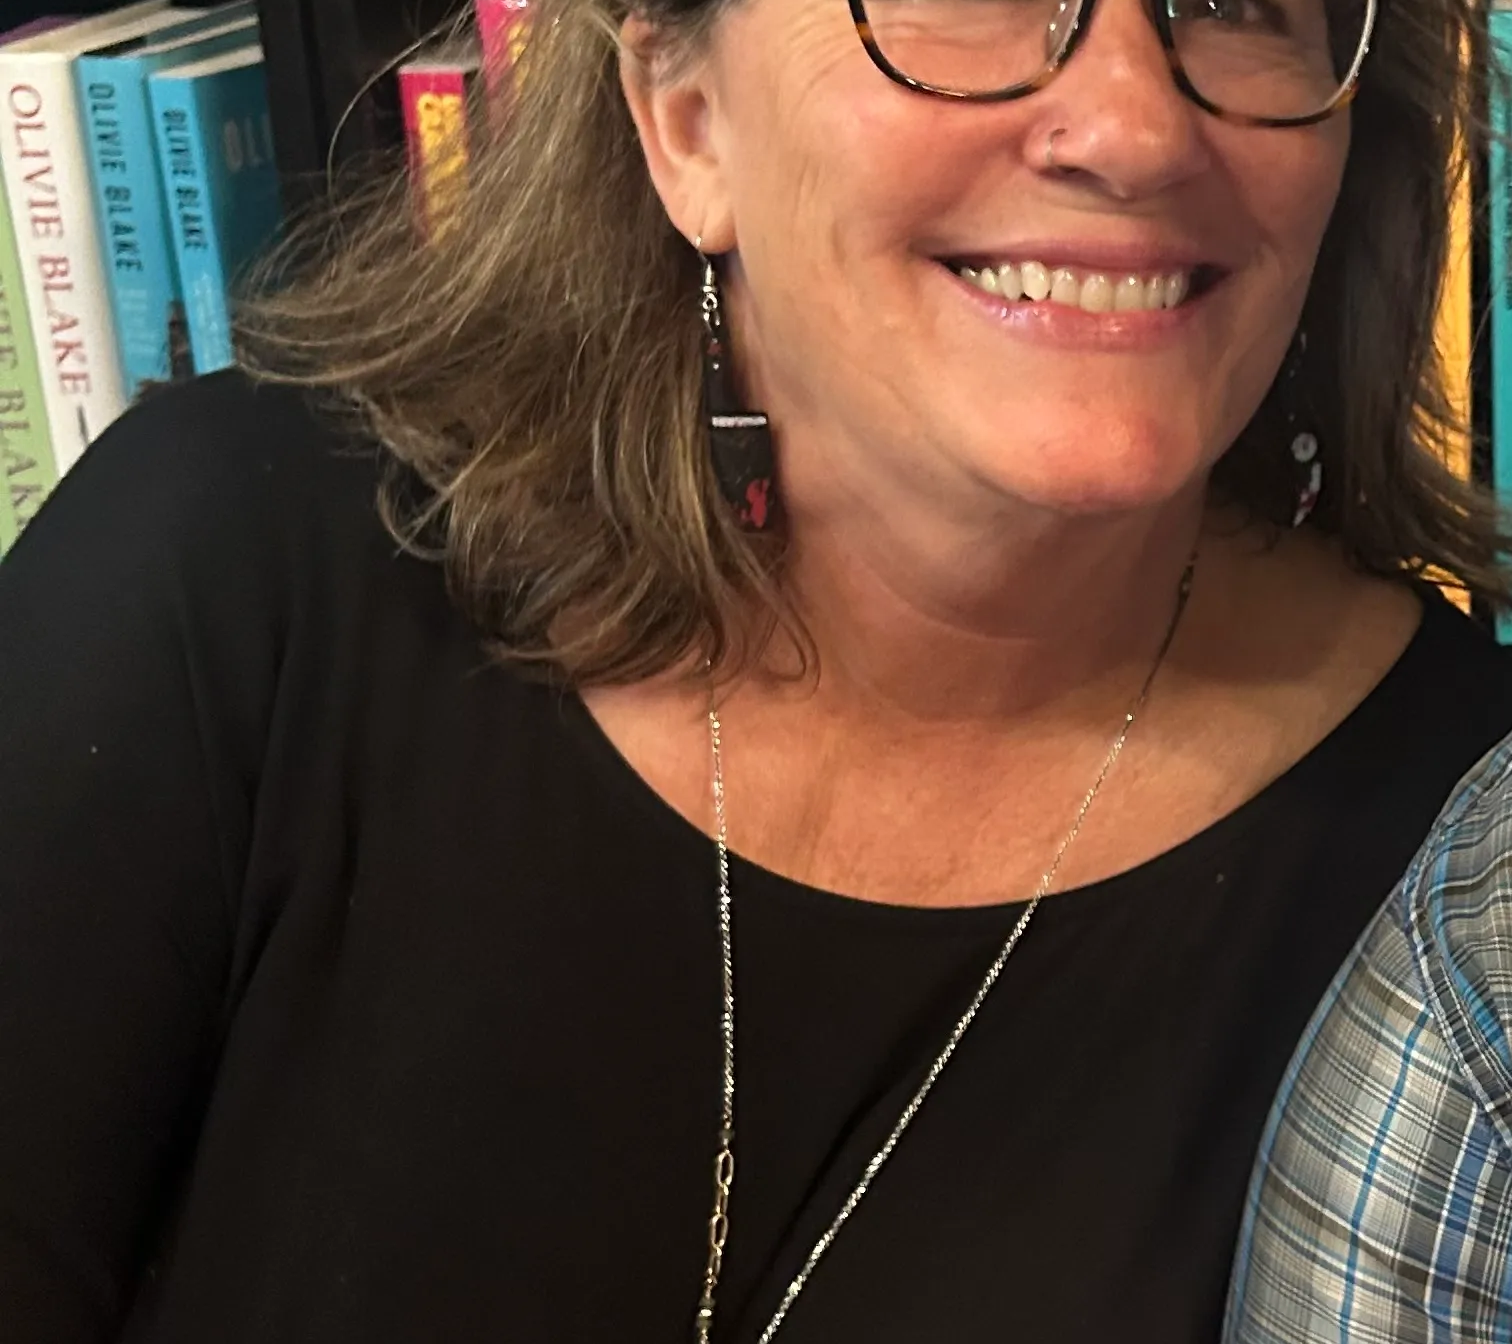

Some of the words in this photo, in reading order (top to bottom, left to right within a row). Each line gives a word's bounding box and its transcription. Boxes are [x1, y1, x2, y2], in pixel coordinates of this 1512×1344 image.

[88, 81, 128, 175] OLIVIE
[162, 108, 198, 178] OLIVIE
[8, 82, 65, 240] OLIVIE
[38, 255, 91, 396] BLAKE
[104, 184, 144, 272] BLAKE
[174, 185, 208, 252] BLAKE
